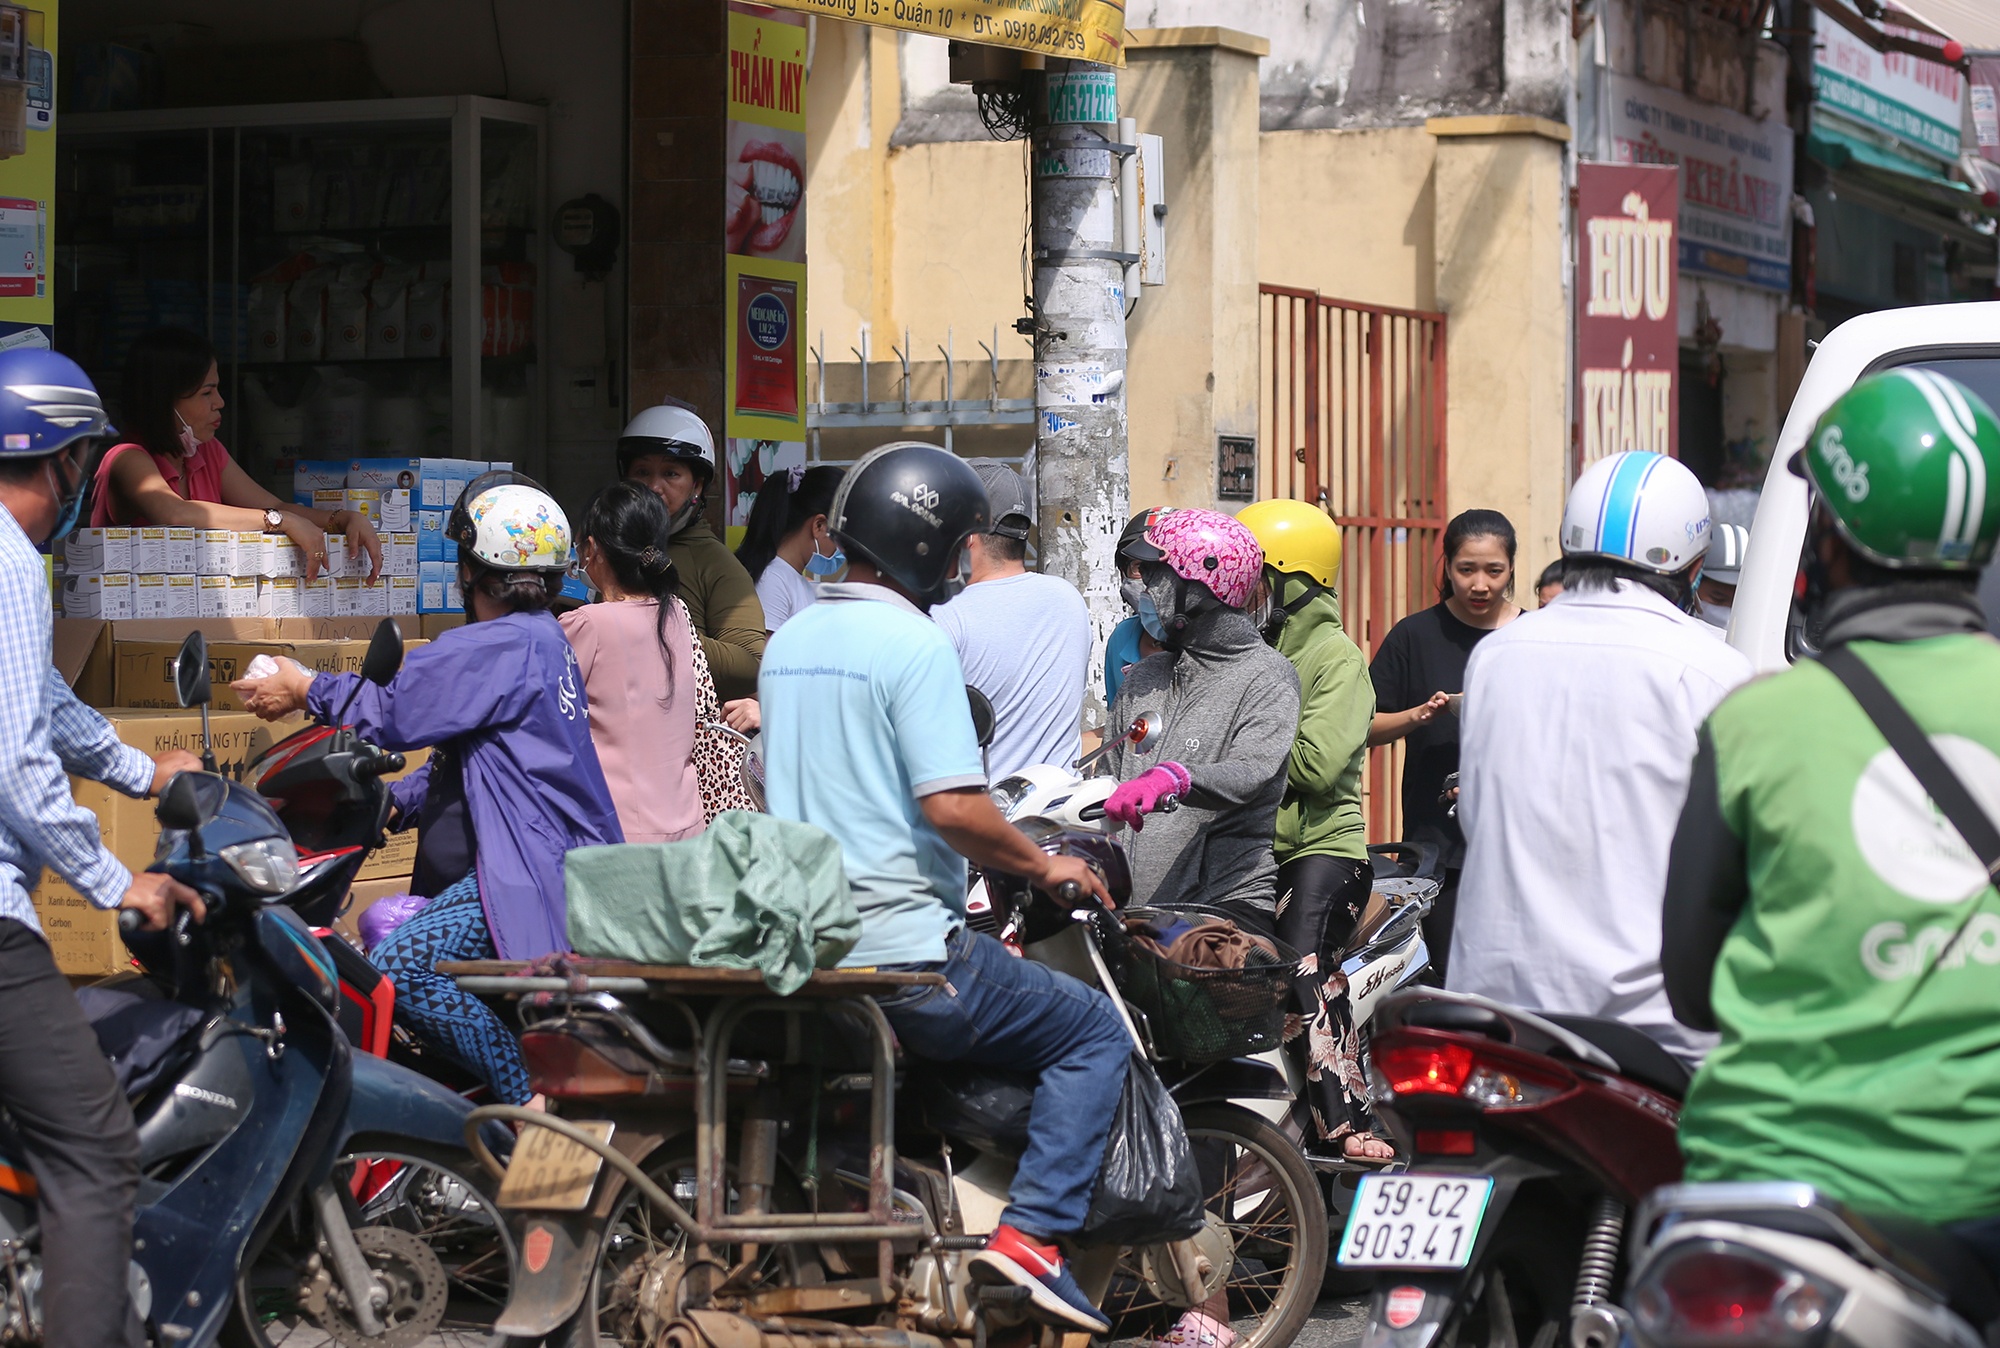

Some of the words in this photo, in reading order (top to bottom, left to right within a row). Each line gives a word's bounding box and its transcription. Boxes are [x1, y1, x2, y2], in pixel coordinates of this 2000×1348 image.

[863, 0, 879, 16] 15
[894, 0, 933, 27] Quận
[939, 7, 953, 29] 10
[973, 14, 1000, 36] ĐT:
[1003, 19, 1086, 51] 0918.092.759
[731, 27, 775, 109] THẨM
[779, 48, 804, 114] MỸ
[1684, 155, 1782, 226] KHÁNH
[1582, 335, 1672, 472] KHÁNH
[1819, 424, 1870, 503] Grab
[315, 652, 343, 673] KHẨU
[155, 729, 188, 752] KHẨU
[233, 731, 241, 749] Y
[243, 727, 257, 748] TẾ
[48, 895, 65, 907] Xanh
[49, 917, 72, 928] Carbon
[1373, 1180, 1469, 1219] 59-C2
[1350, 1223, 1464, 1261] 903.41
